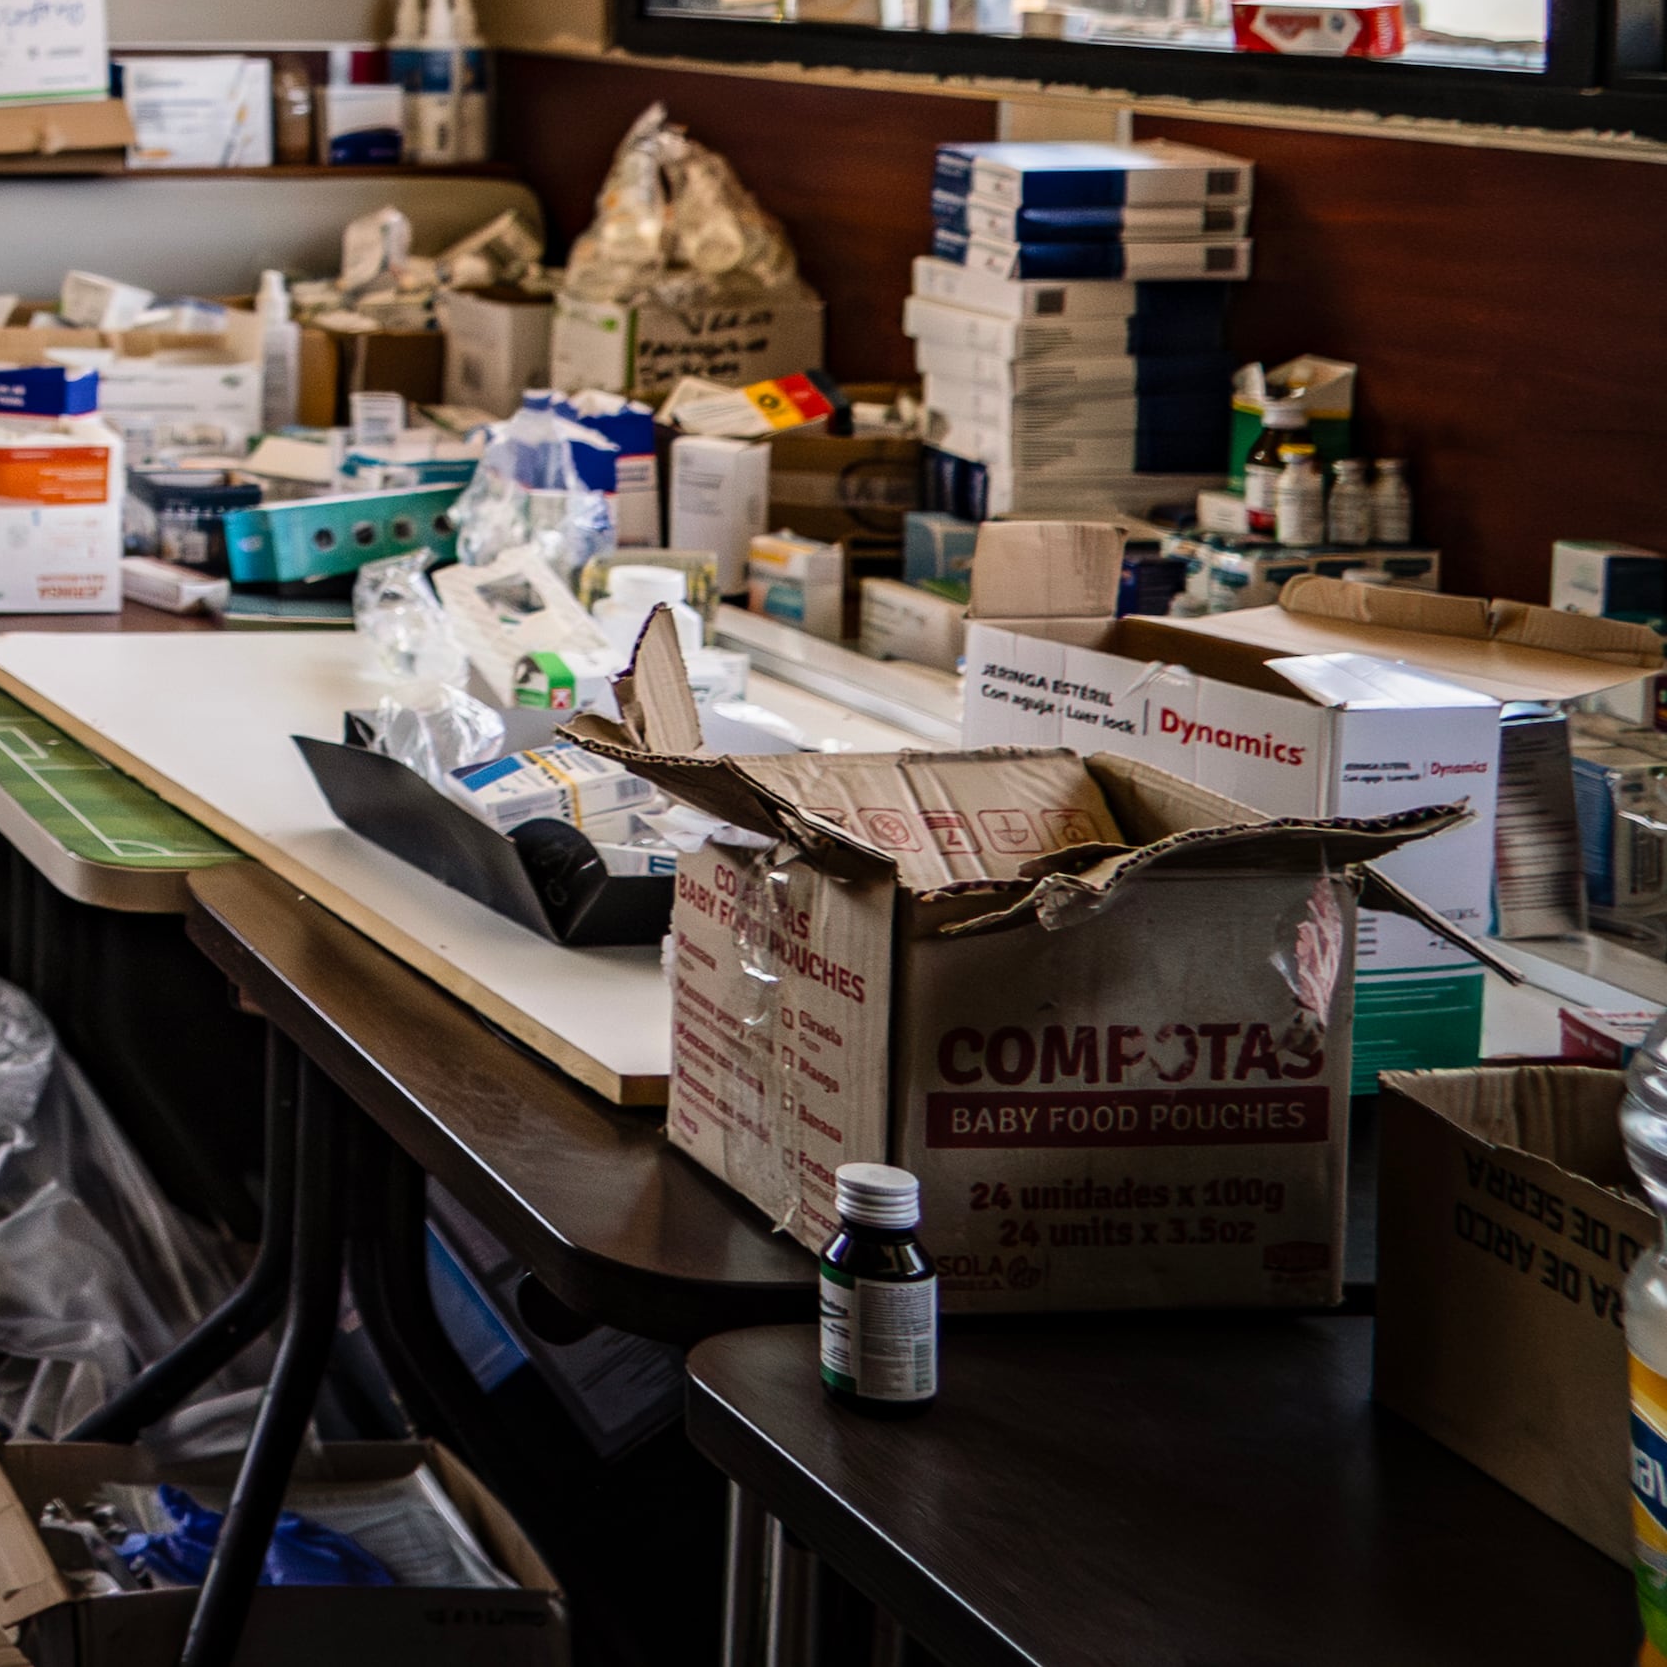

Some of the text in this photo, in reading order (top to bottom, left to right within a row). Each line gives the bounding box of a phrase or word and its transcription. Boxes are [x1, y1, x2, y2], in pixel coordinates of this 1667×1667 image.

[981, 663, 1048, 690] JERINGA
[981, 684, 1010, 702] Con
[1012, 693, 1055, 715] aguja
[1160, 709, 1306, 766] Dynamics
[1430, 761, 1488, 777] Dynamics
[678, 872, 717, 918] BABY
[769, 928, 866, 1004] POUCHES
[799, 1009, 842, 1047] Ciruela
[798, 1056, 839, 1094] Mango
[798, 1103, 842, 1144] Banana
[951, 1101, 1307, 1134] BABY FOOD POUCHES
[970, 1179, 1285, 1213] 24 unidades x 100g
[1464, 1145, 1565, 1235] SERRA
[999, 1217, 1257, 1247] 24 units x 3.5oz
[1453, 1200, 1536, 1275] ARCO
[1570, 1205, 1612, 1260] DE
[936, 1254, 1004, 1277] SOLA
[1541, 1248, 1581, 1305] DE
